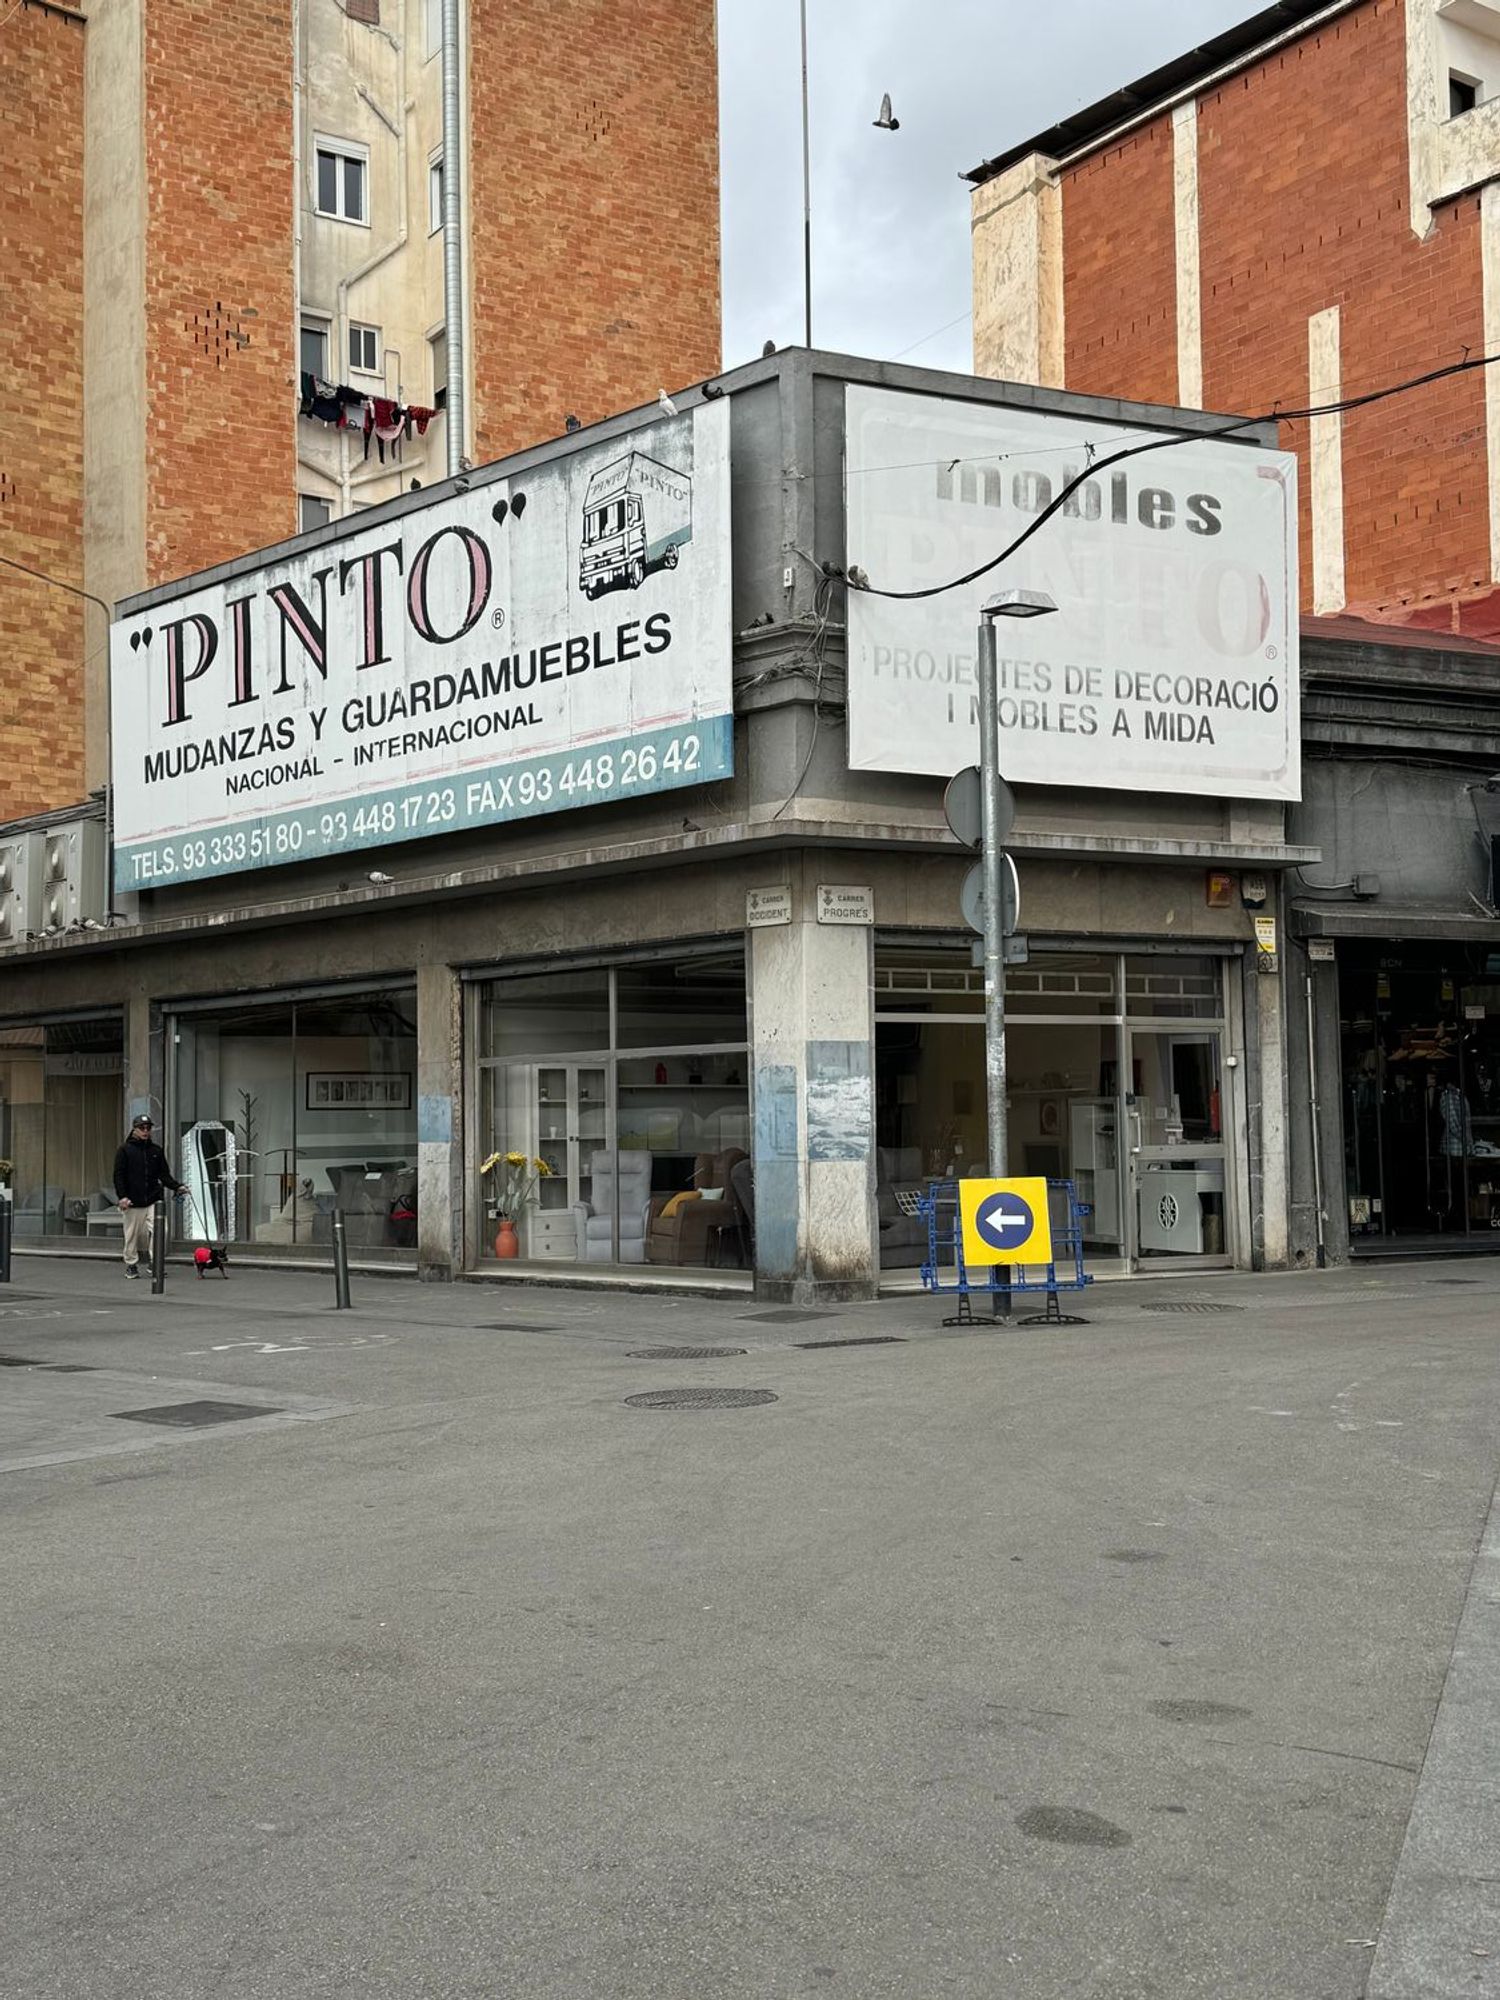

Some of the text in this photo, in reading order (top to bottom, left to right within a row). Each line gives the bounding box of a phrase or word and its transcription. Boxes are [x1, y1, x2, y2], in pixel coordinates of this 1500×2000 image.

[936, 462, 1222, 537] mobles
[144, 612, 672, 783] MUDANZAS Y GUARDAMUEBLES
[873, 645, 1279, 713] PROJETES DE DECORACIÓ
[225, 756, 324, 796] NACIONAL
[353, 702, 543, 767] INTERNACIONAL
[947, 693, 955, 723] I
[1112, 708, 1132, 739] A
[1144, 711, 1216, 745] MIDA
[131, 848, 179, 880] TELS.
[182, 840, 206, 870] 93
[210, 831, 247, 863] 333
[320, 811, 348, 845] 93
[352, 800, 397, 838] 448
[466, 774, 515, 816] FAX
[518, 767, 553, 806] 93
[559, 754, 615, 796] 448
[620, 744, 657, 785] 26
[749, 907, 788, 921] OCCIDENT
